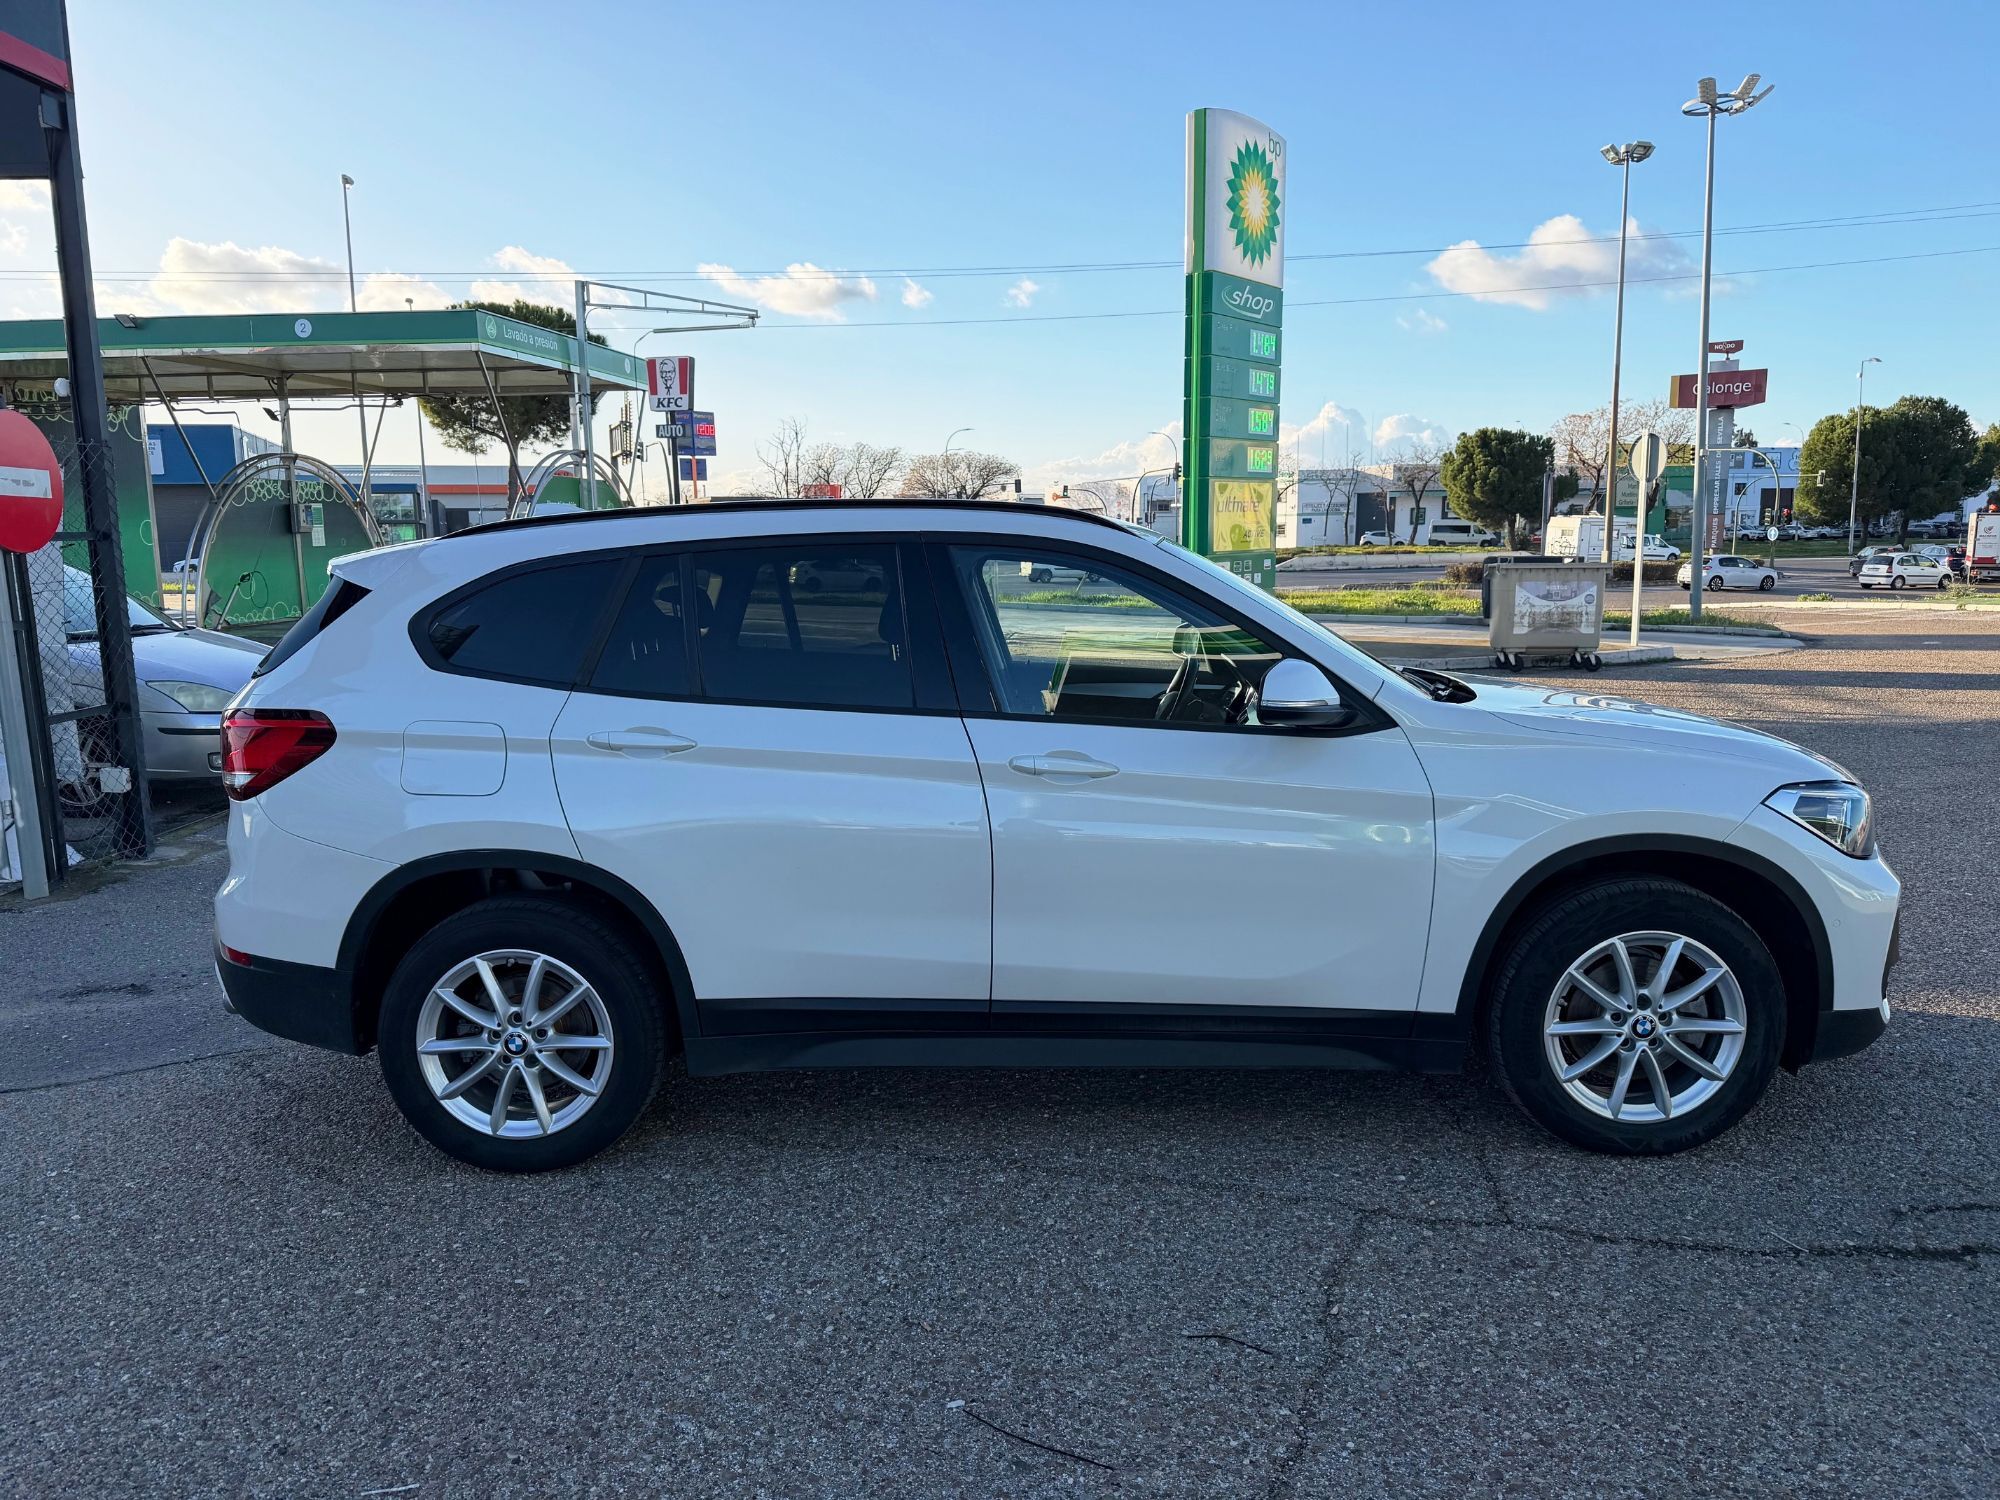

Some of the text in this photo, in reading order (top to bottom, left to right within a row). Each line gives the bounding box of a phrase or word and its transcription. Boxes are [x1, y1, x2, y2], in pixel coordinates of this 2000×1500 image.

[1269, 131, 1281, 160] bp
[1232, 285, 1274, 318] shop
[300, 322, 306, 333] 2
[503, 324, 528, 343] Lavado
[529, 335, 536, 345] a
[656, 396, 683, 409] KFC
[658, 425, 684, 438] AUTO
[1716, 416, 1724, 445] SEVILLA
[1712, 460, 1722, 515] EMPRESARIALES
[1711, 517, 1719, 548] PARQUES
